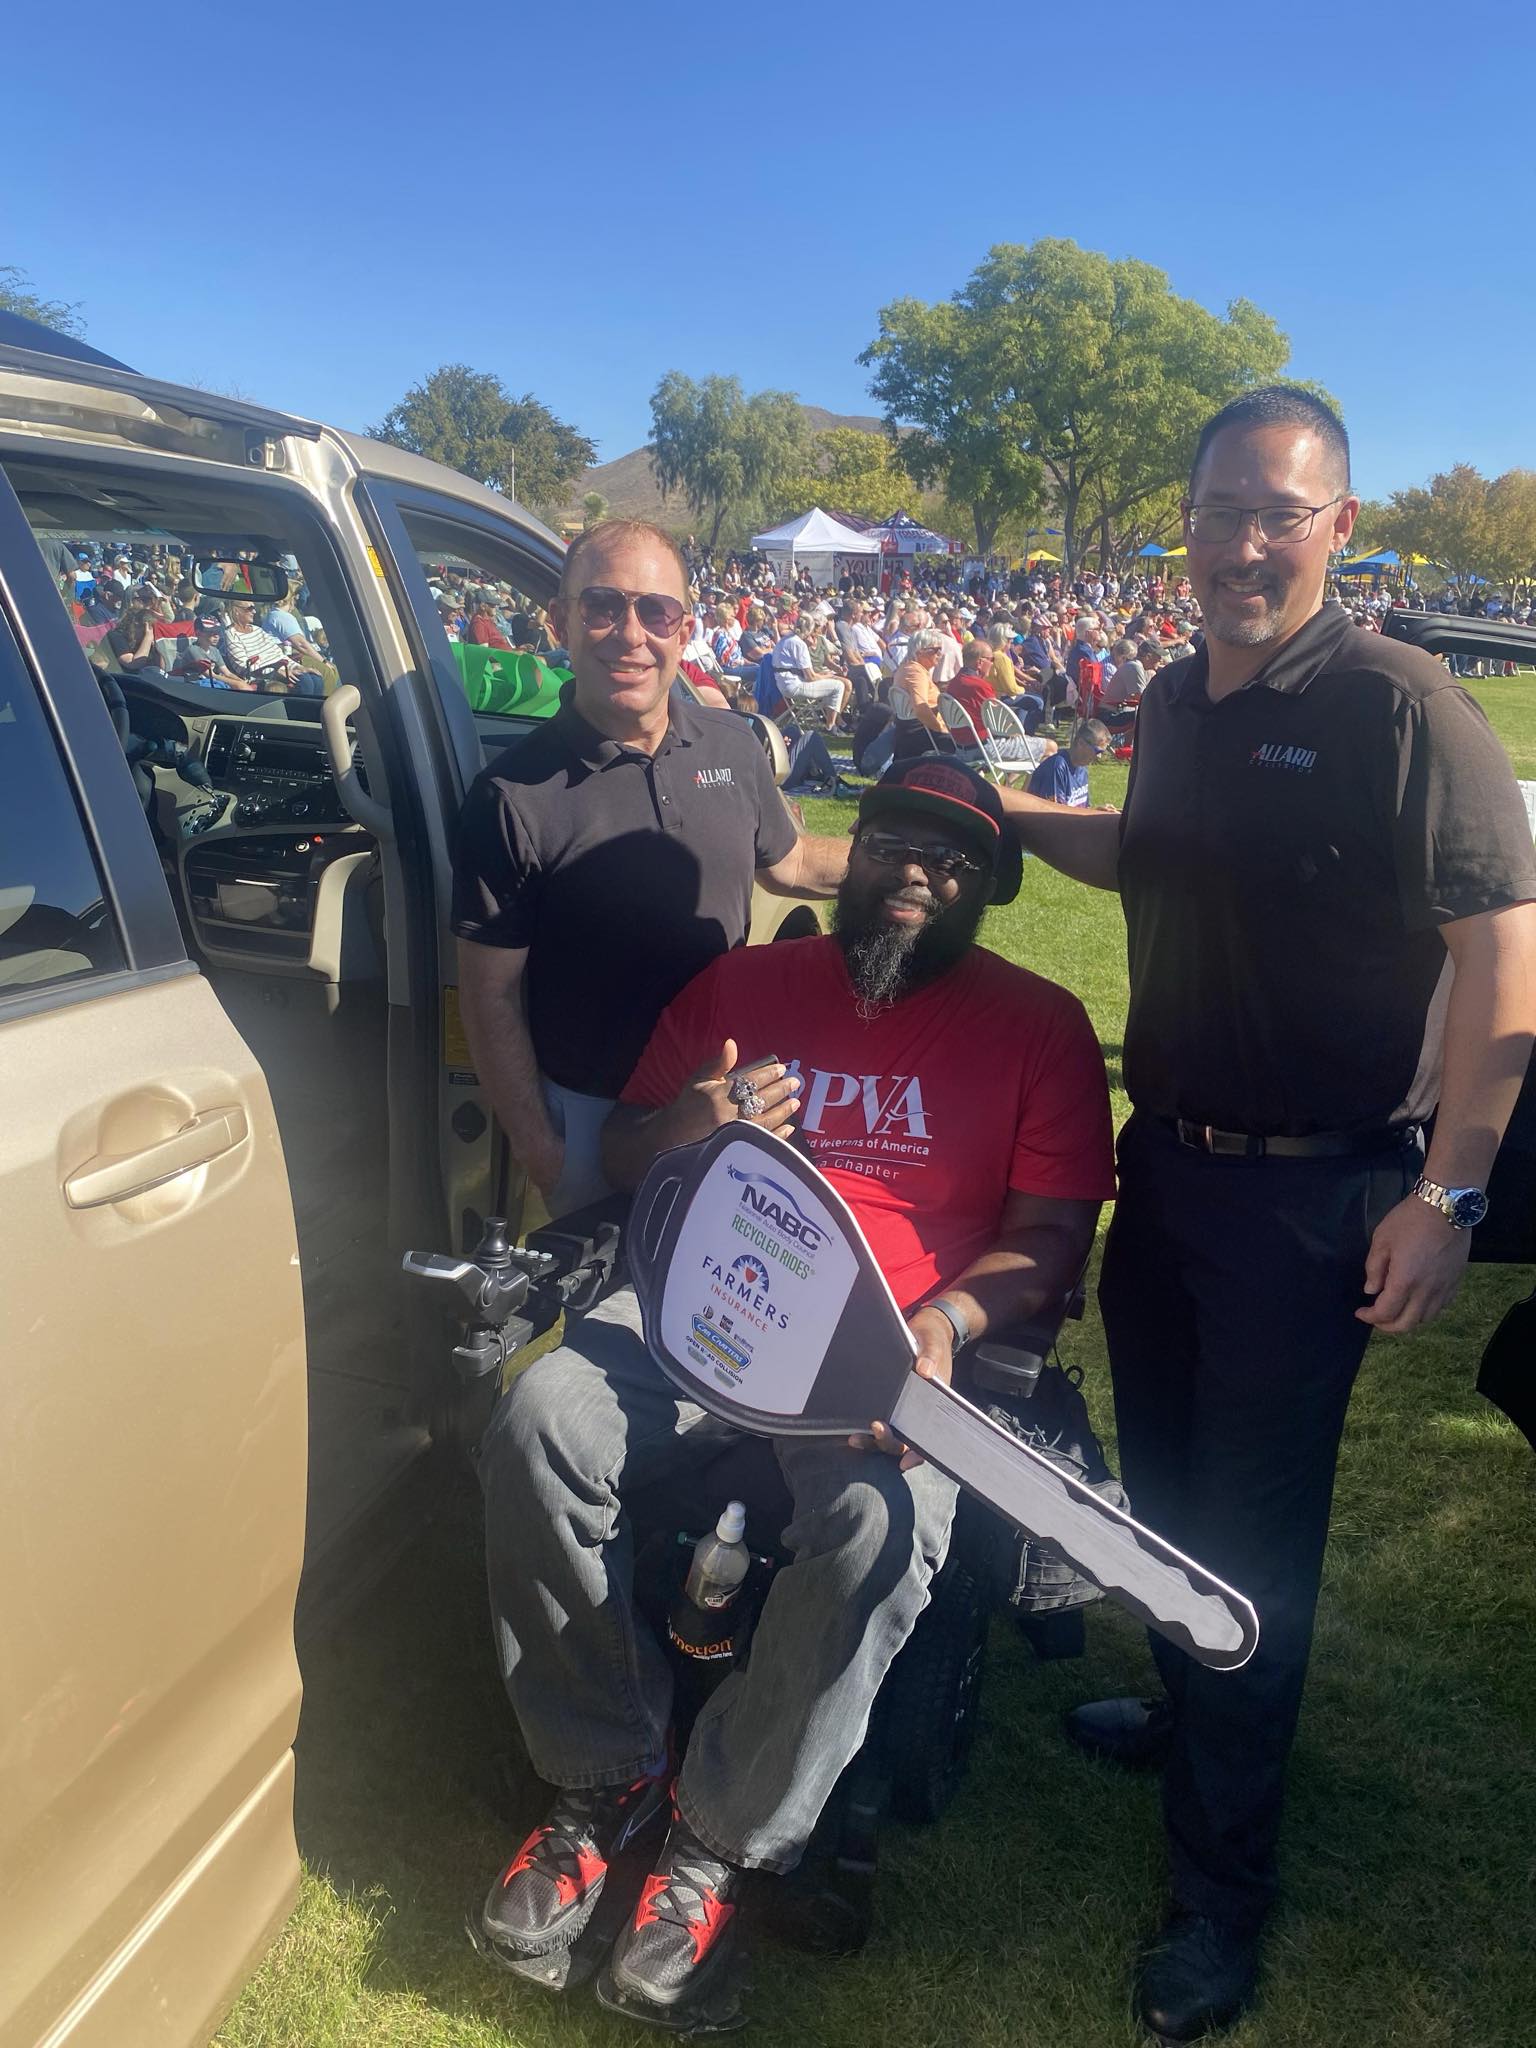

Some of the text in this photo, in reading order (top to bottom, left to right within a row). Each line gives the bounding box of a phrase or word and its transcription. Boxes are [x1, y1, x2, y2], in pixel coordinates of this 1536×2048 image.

[695, 768, 732, 784] ALLARD
[1252, 743, 1317, 768] ALLARD
[802, 1068, 934, 1140] PVA
[834, 1158, 900, 1180] Chapter
[866, 1138, 879, 1149] of
[881, 1141, 930, 1156] America
[731, 1214, 780, 1258] RECYCLED
[741, 1183, 821, 1251] NABC
[702, 1255, 789, 1329] FARMERS
[710, 1283, 769, 1333] INSURANCE
[685, 1335, 700, 1349] OPEN
[700, 1346, 716, 1361] RAD
[715, 1360, 744, 1385] COLLISION
